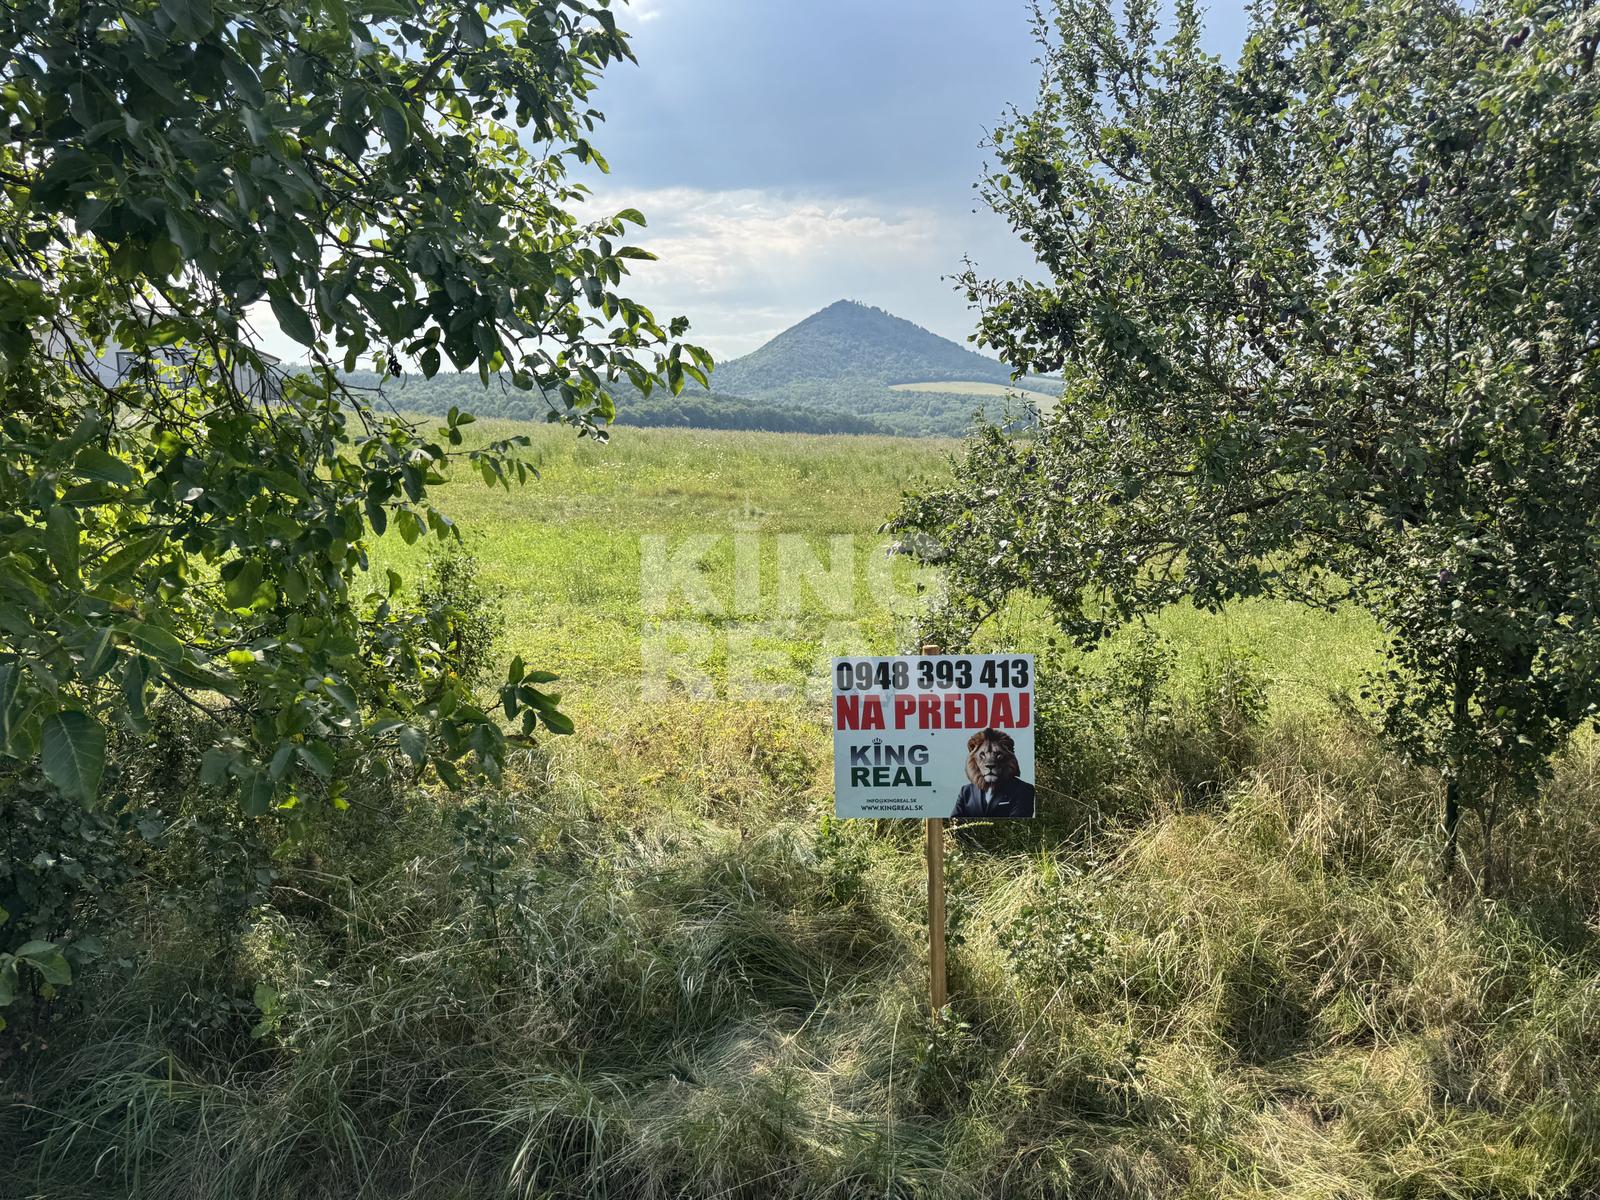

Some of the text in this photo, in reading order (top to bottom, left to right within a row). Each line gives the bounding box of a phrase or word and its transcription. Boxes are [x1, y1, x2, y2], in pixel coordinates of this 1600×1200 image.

[836, 659, 1029, 690] 0948 393 413
[836, 692, 1030, 730] NA PREDAJ
[850, 744, 930, 766] KING
[851, 766, 932, 787] REAL
